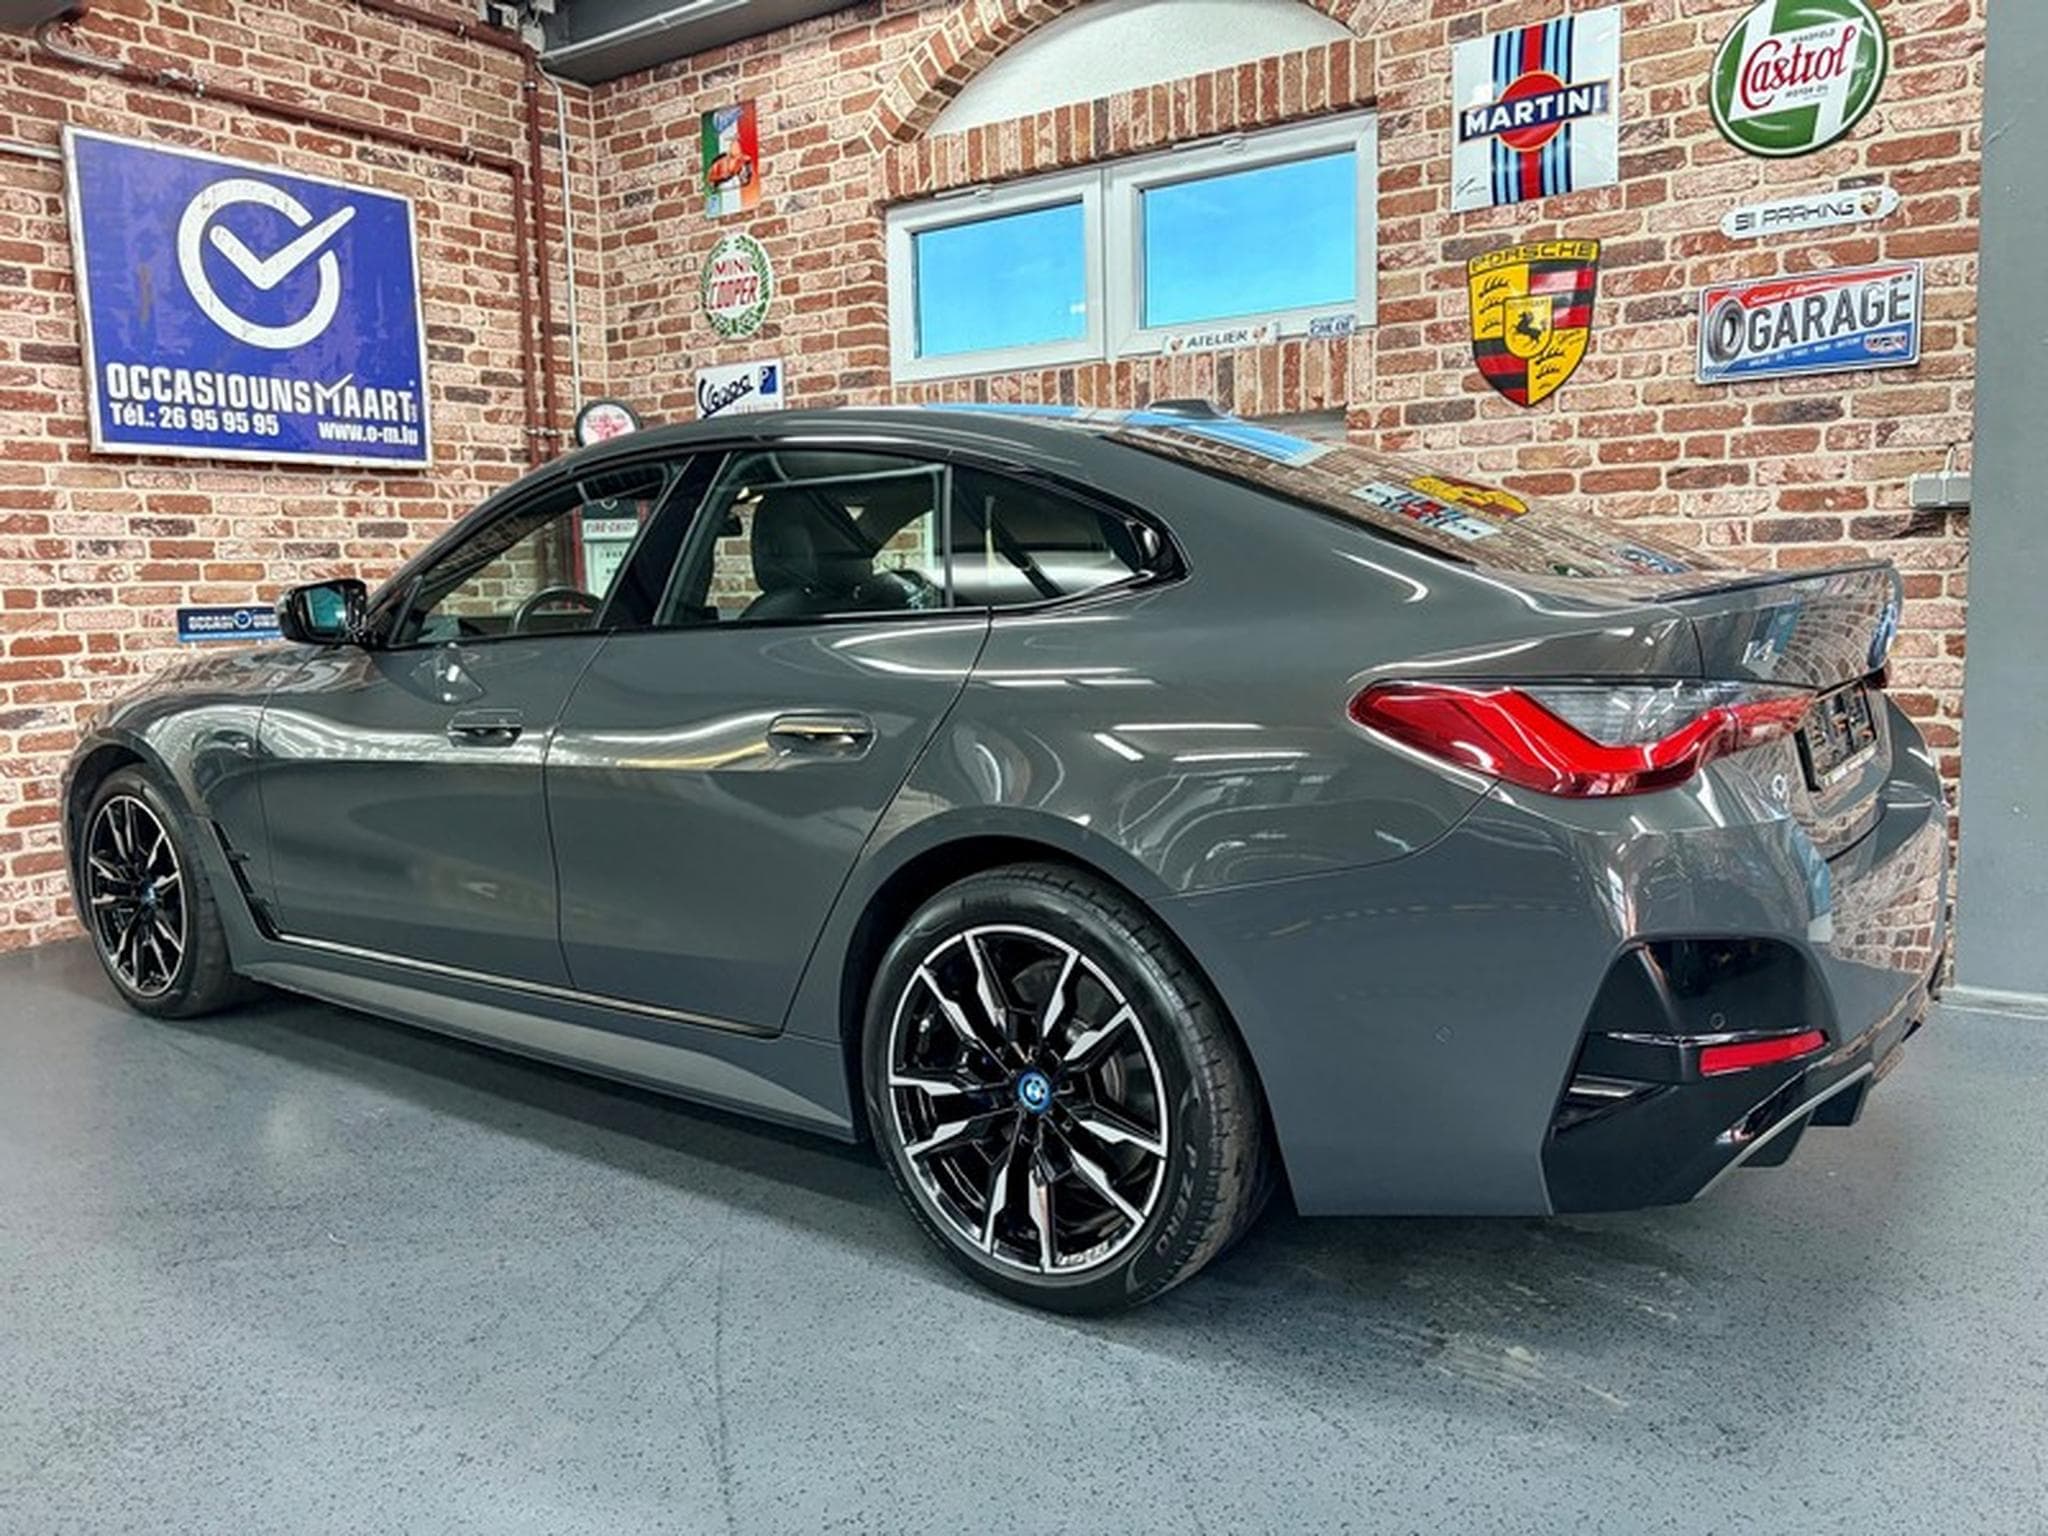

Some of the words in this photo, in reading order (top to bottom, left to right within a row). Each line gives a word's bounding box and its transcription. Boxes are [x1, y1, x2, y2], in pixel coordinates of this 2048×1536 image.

[1741, 25, 1856, 110] Castrol
[1464, 86, 1602, 137] MARTINI
[1761, 201, 1856, 226] PARKING
[714, 257, 752, 276] MINI
[1472, 242, 1591, 271] PORSCHE
[709, 275, 758, 309] COOPER
[1748, 283, 1912, 354] GARAGE
[1187, 329, 1248, 349] ATELIER
[106, 362, 413, 422] OCCASIOUNSMAART
[698, 375, 754, 419] Vespa
[110, 403, 155, 427] Tél.:
[160, 406, 187, 429] 26
[192, 408, 219, 431] 95
[223, 410, 249, 434] 95
[253, 413, 280, 436] 95
